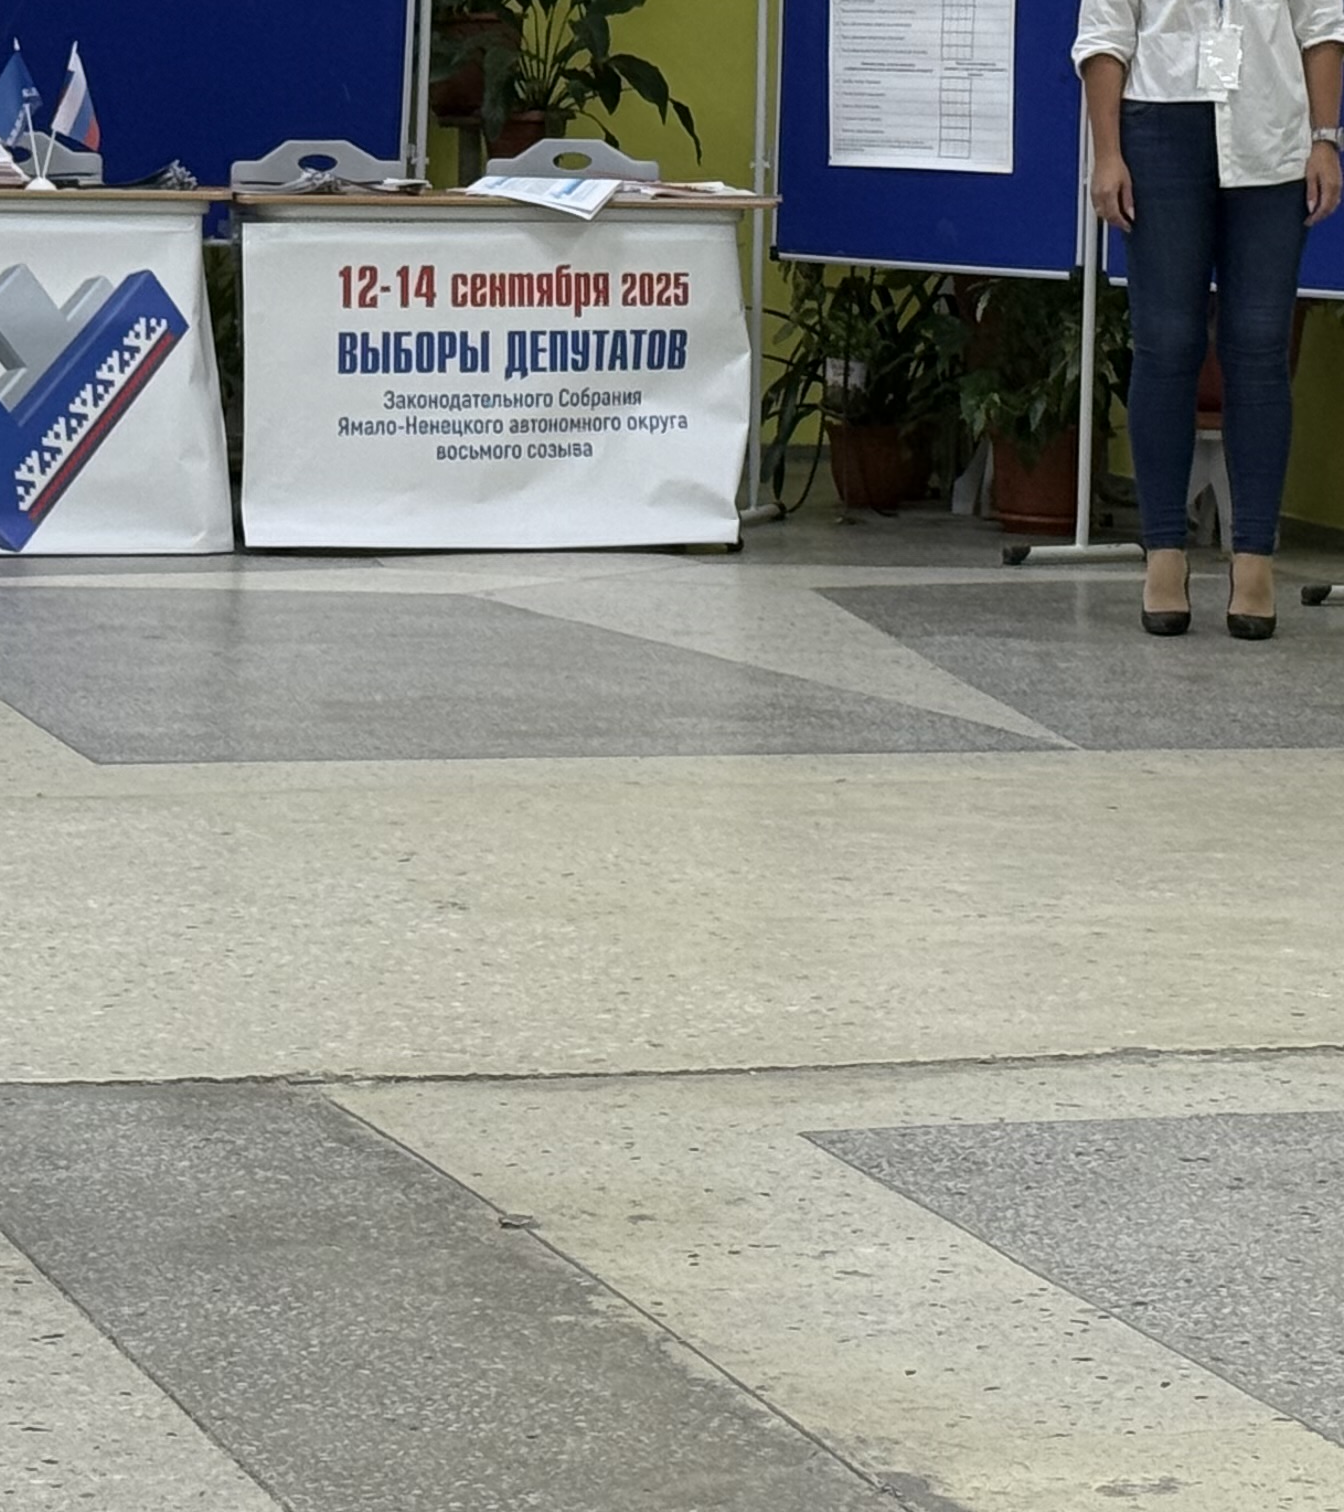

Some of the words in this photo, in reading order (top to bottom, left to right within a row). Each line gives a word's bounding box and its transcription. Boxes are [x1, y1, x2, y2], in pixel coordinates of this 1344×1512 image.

[338, 265, 437, 308] 12-14
[450, 264, 610, 318] сентября
[621, 272, 690, 307] 2025
[337, 331, 490, 374] ВЫБОРЫ
[504, 329, 688, 381] ДЕПУТАТОВ
[383, 390, 554, 411] Законодательного
[558, 387, 642, 409] Собрания
[337, 416, 504, 438] Ямало-Ненецкого
[508, 415, 621, 434] автономного
[627, 413, 688, 434] округа
[436, 443, 522, 461] восьмого
[527, 442, 593, 459] созыва
